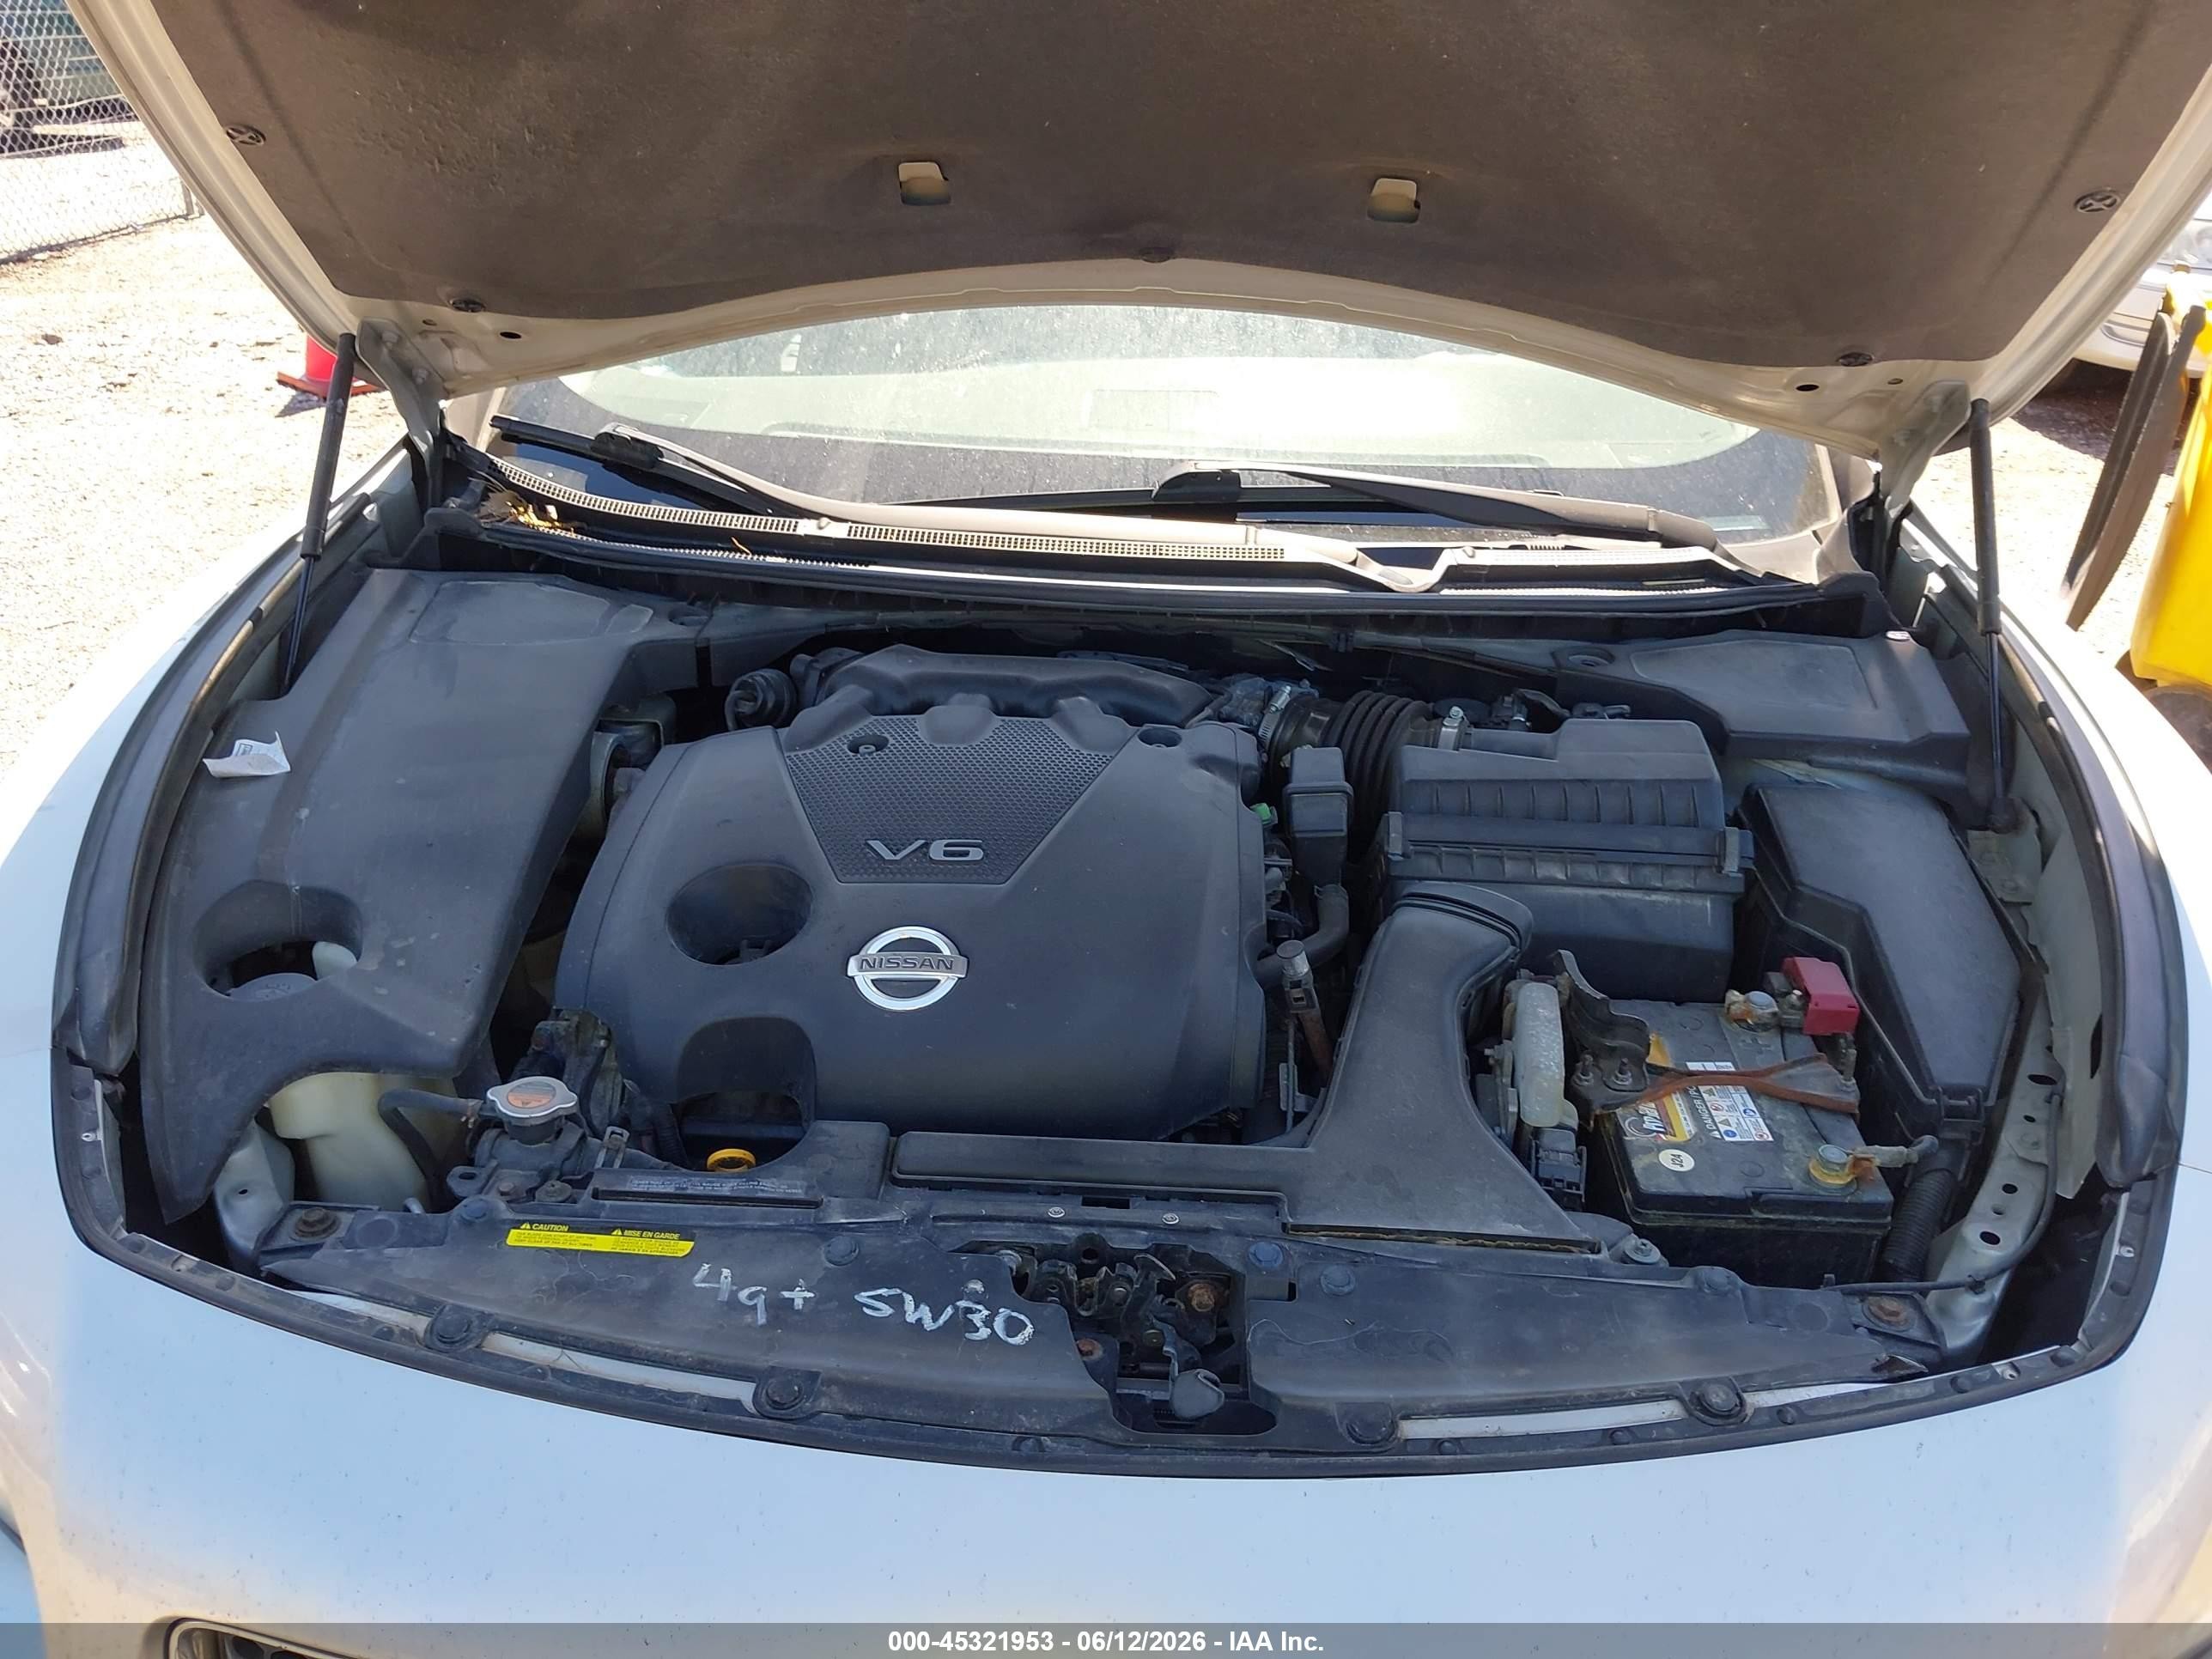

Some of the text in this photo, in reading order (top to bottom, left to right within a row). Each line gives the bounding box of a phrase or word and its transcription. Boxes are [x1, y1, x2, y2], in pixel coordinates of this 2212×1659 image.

[866, 838, 984, 862] V6
[860, 956, 955, 971] NISSAN
[1670, 1153, 1684, 1168] J24
[532, 1223, 568, 1231] CAUTION
